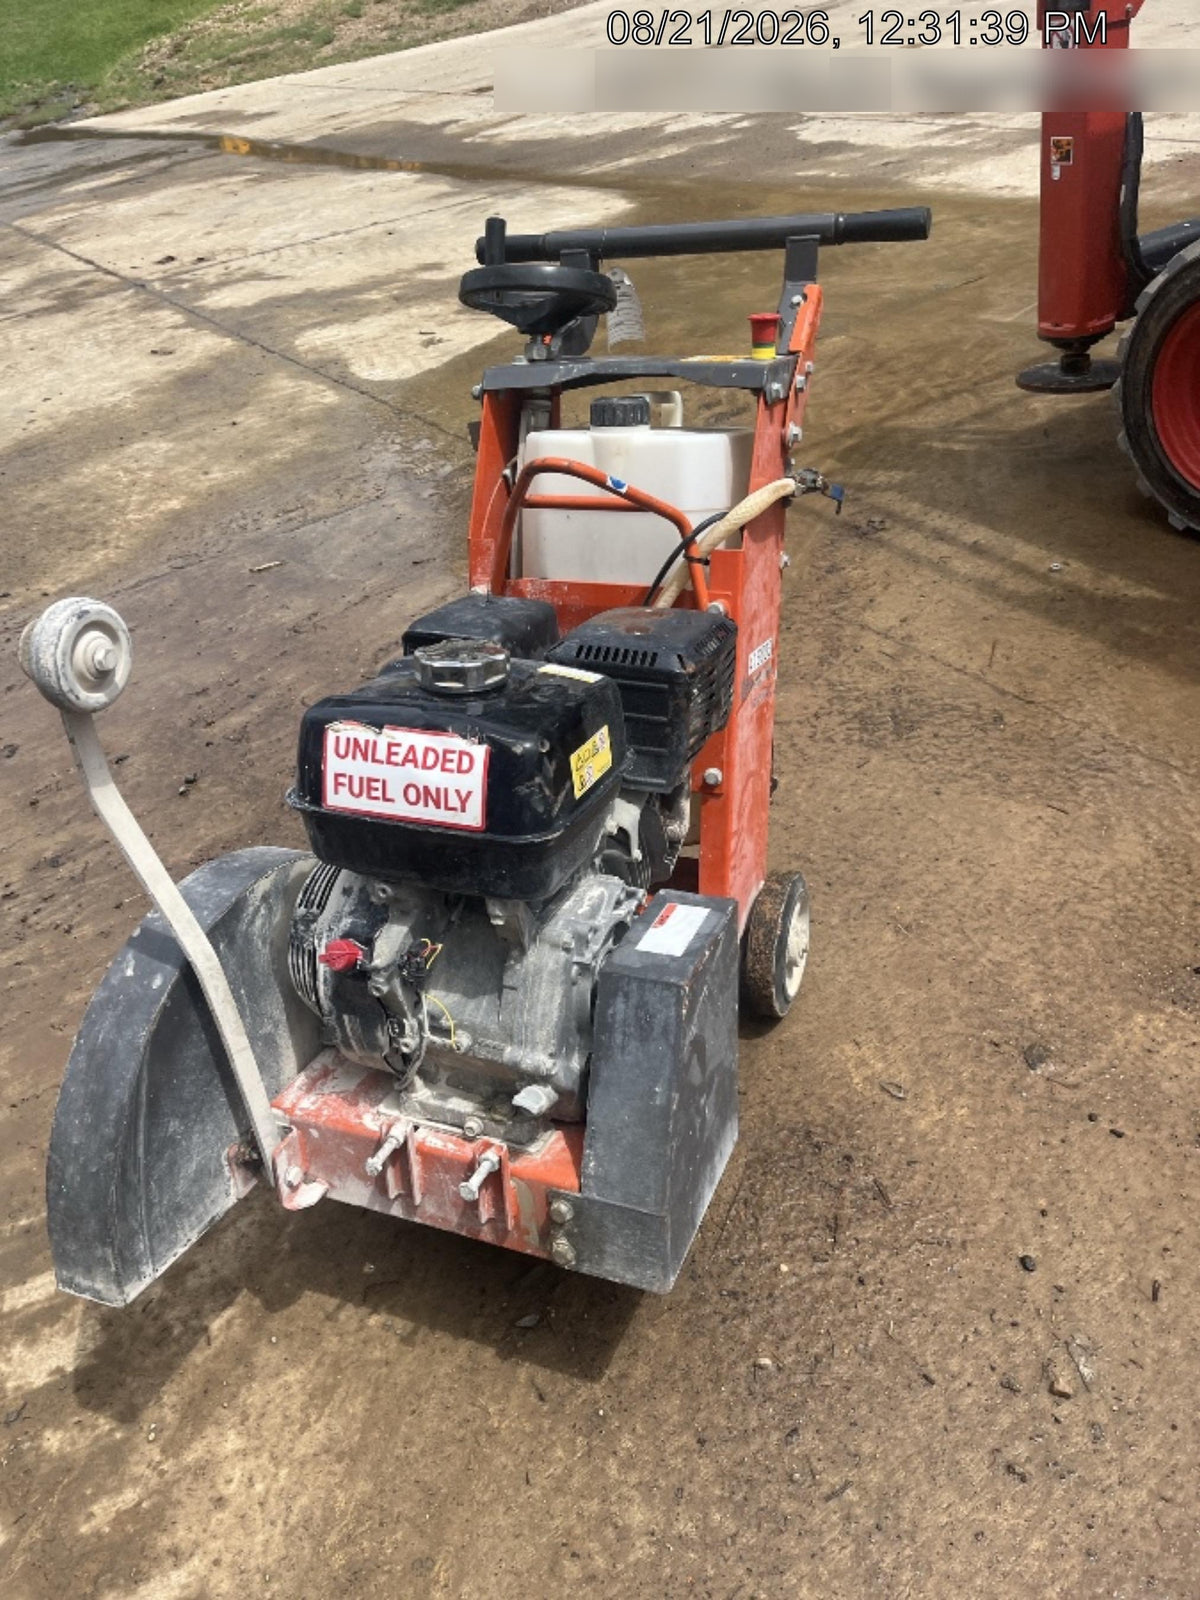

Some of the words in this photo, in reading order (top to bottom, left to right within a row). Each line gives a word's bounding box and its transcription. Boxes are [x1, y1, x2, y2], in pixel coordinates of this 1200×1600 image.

[333, 736, 475, 774] UNLEADED
[333, 773, 396, 803] FUEL
[402, 783, 474, 813] ONLY
